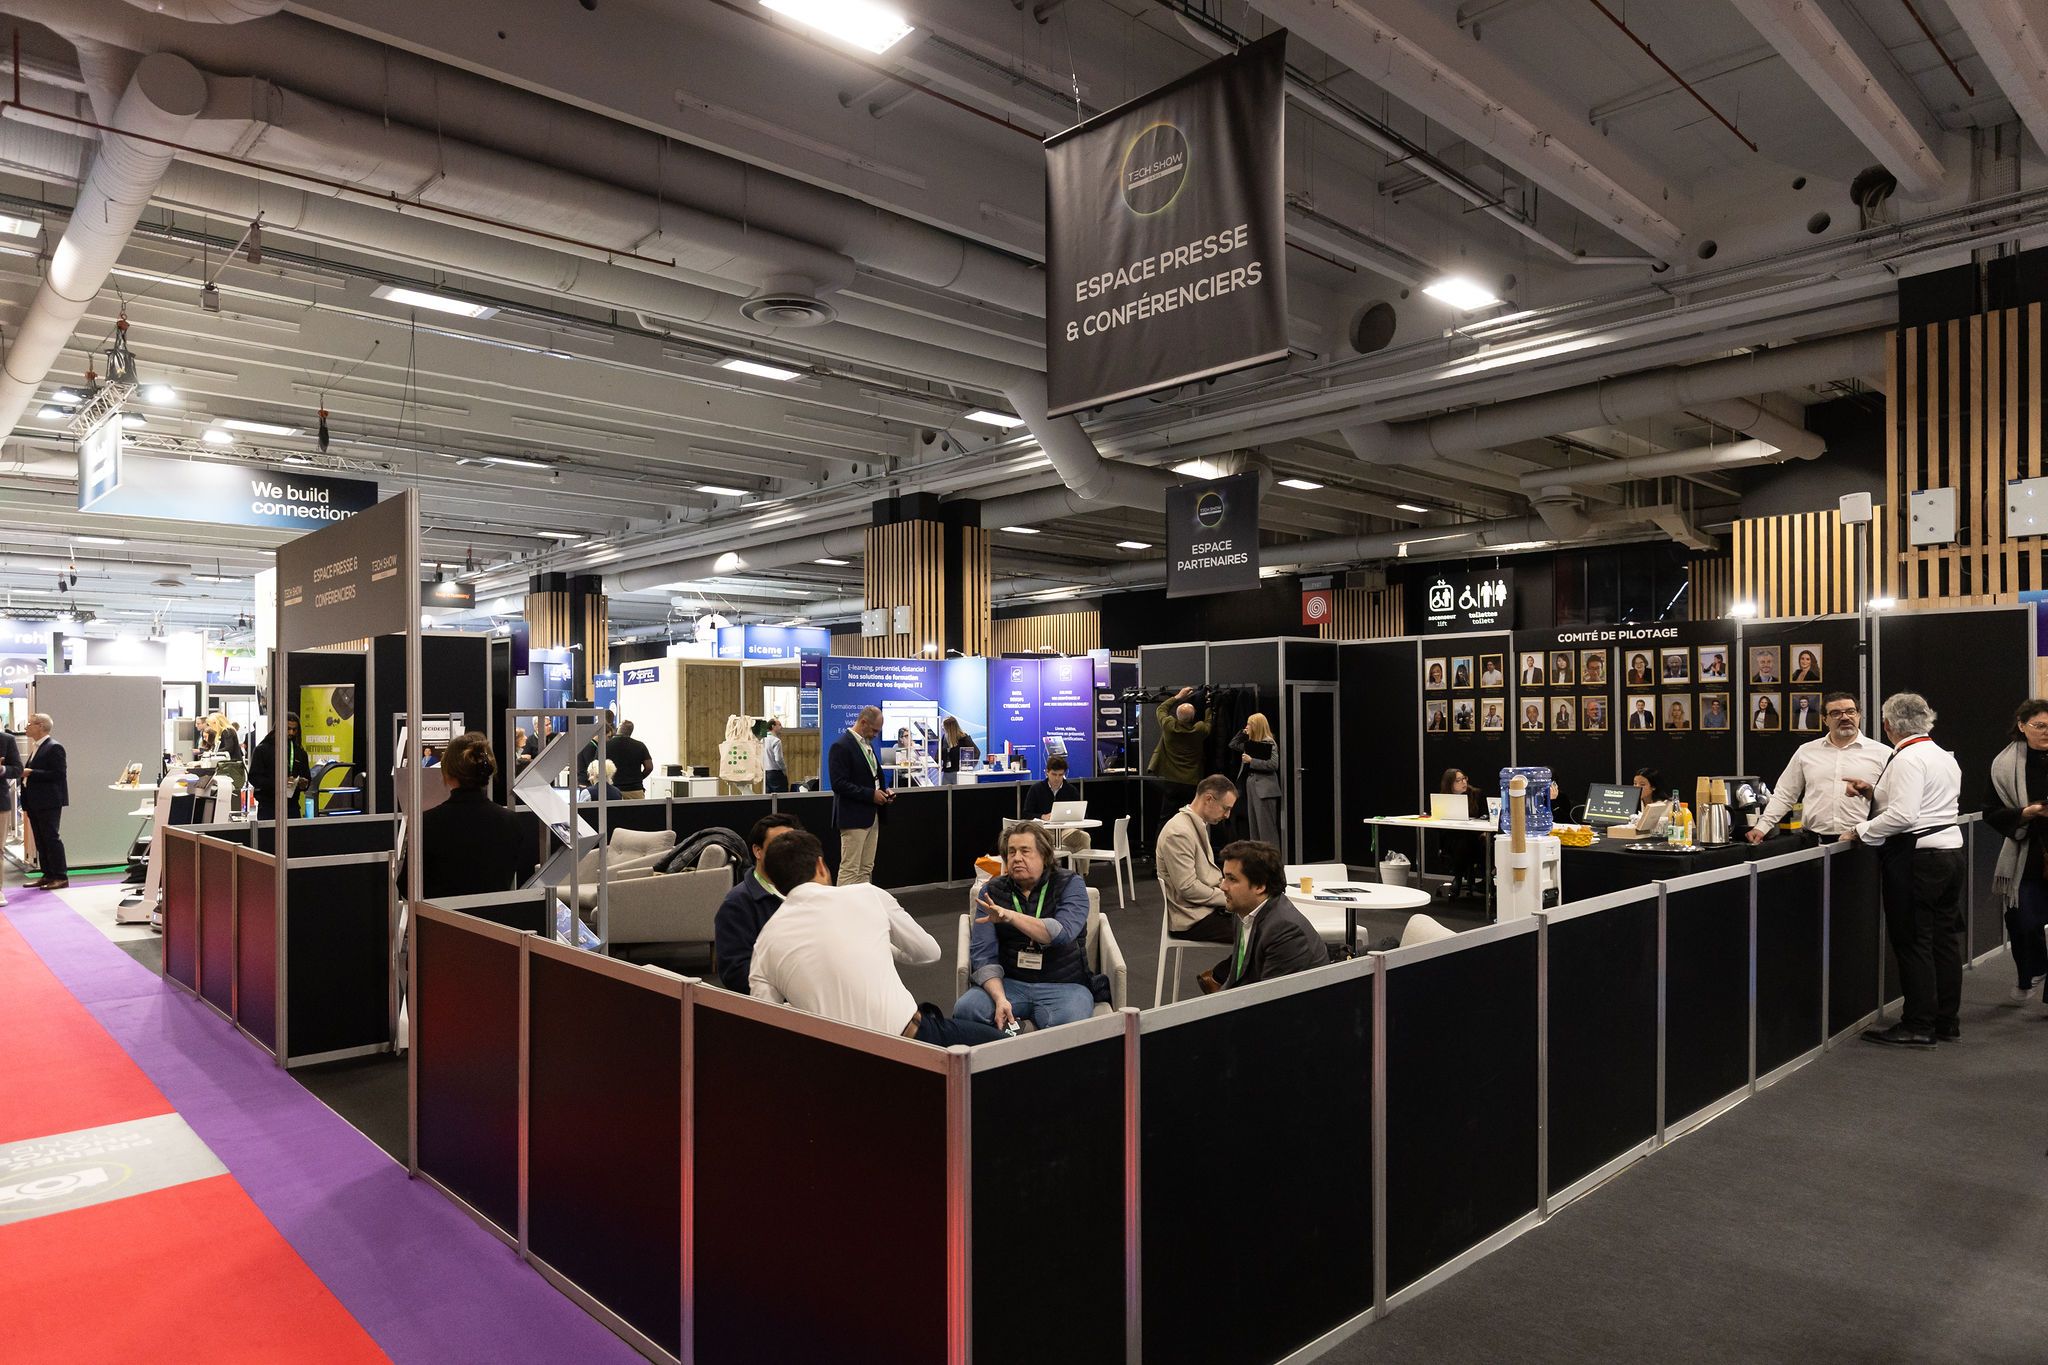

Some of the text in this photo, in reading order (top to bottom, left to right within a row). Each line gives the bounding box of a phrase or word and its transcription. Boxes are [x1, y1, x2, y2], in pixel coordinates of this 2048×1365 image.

[1128, 151, 1183, 182] TECH SHOW
[1076, 224, 1248, 302] ESPACE PRESSE
[1066, 262, 1262, 341] & CONFÉRENCIERS
[251, 480, 329, 503] We build
[1191, 540, 1232, 555] ESPACE
[313, 563, 333, 582] ESPACE
[333, 558, 353, 577] PRESSE
[371, 554, 397, 573] TECH SHOW
[1177, 553, 1248, 571] PARTENAIRES
[315, 584, 356, 608] CONFÉRENCIERS
[1557, 628, 1678, 642] COMITÉ DE PILOTAGE
[749, 645, 783, 655] sicame
[874, 665, 901, 673] présentiel,
[595, 678, 617, 688] sicame
